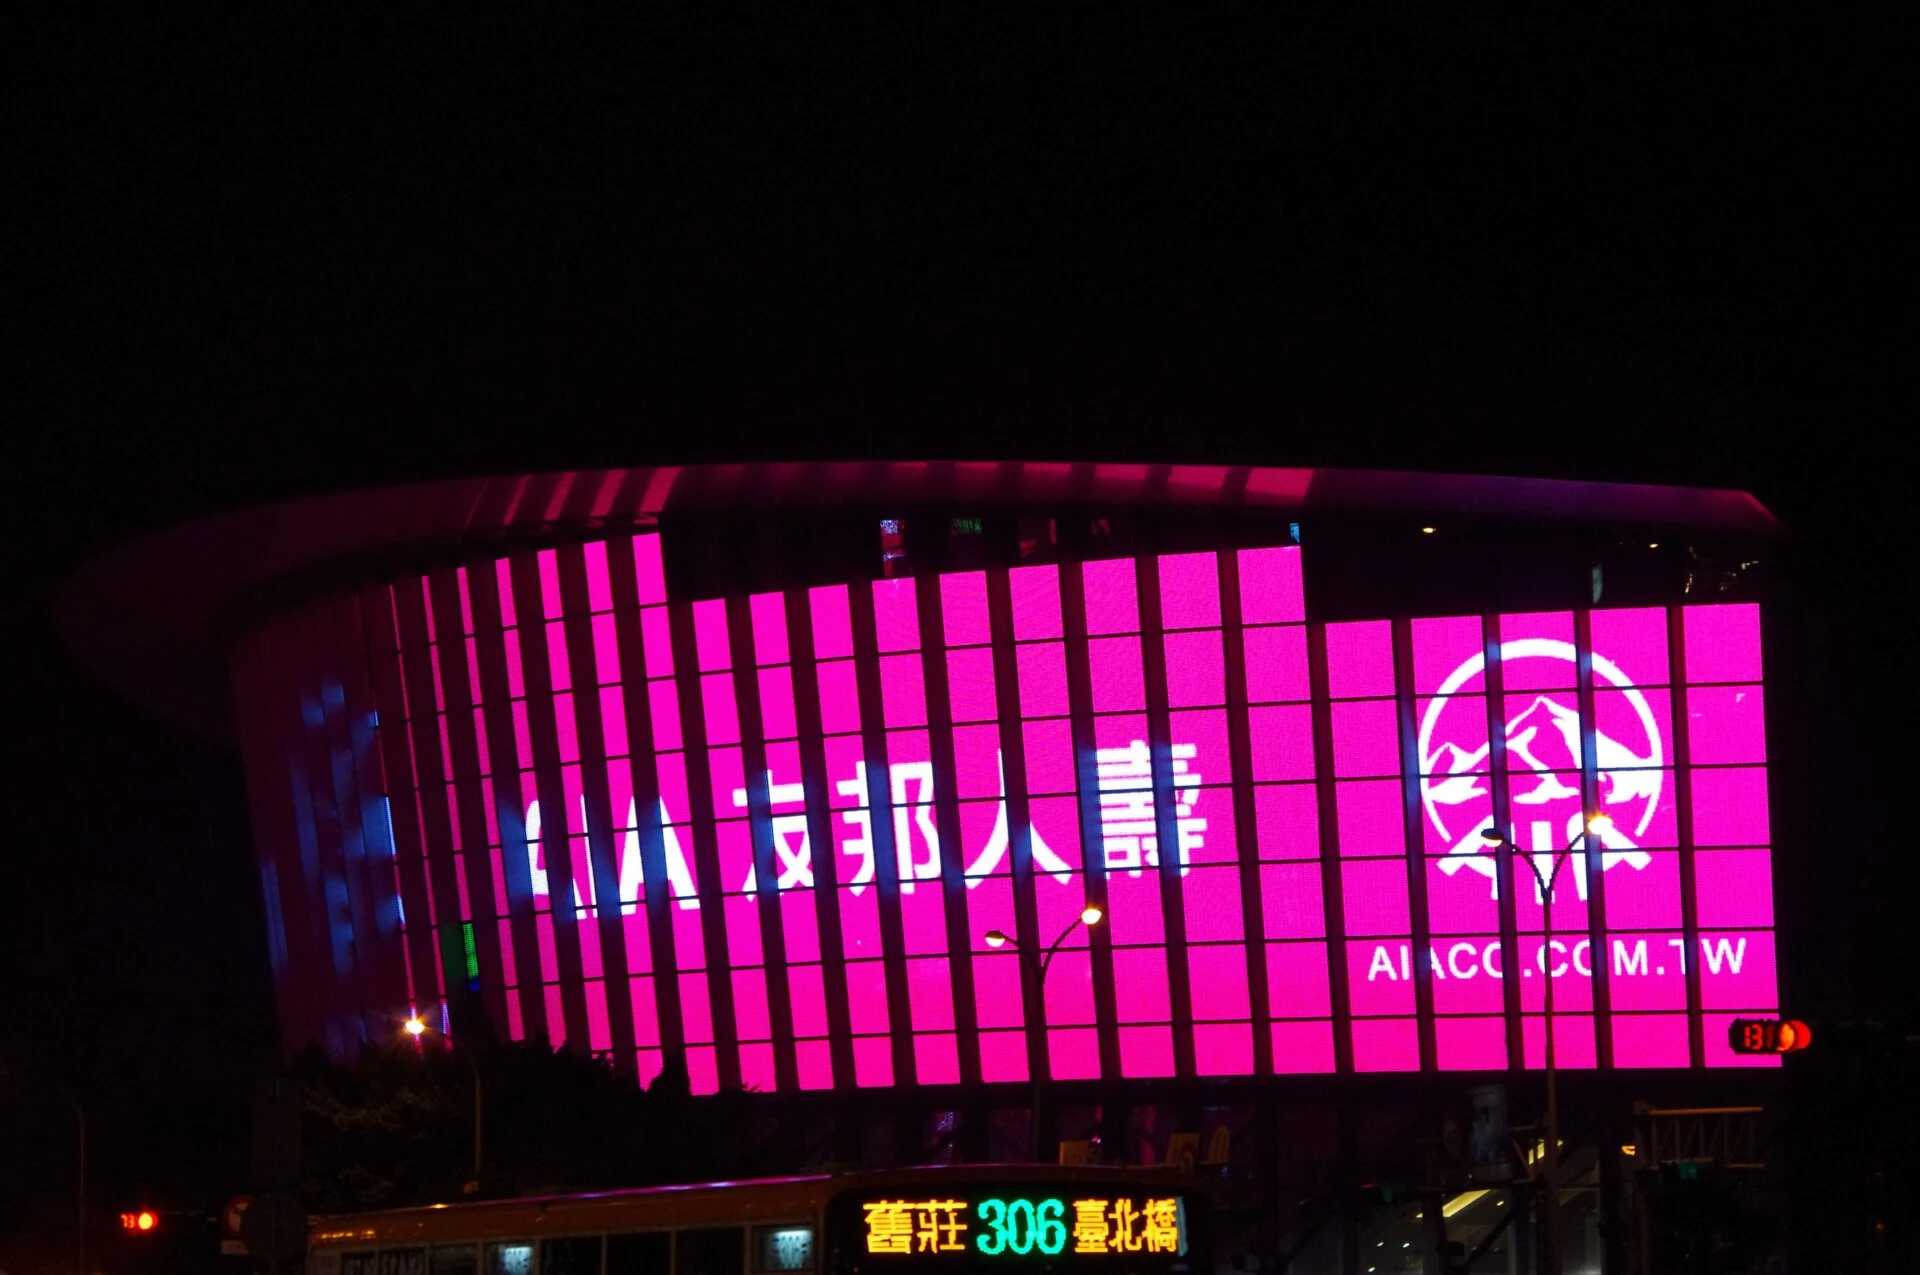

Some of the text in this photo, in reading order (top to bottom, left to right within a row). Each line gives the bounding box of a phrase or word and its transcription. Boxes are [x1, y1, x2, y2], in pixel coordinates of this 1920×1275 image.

[522, 739, 1208, 920] AA 友邦人壽
[863, 1199, 1178, 1254] 舊莊 306 臺北橋
